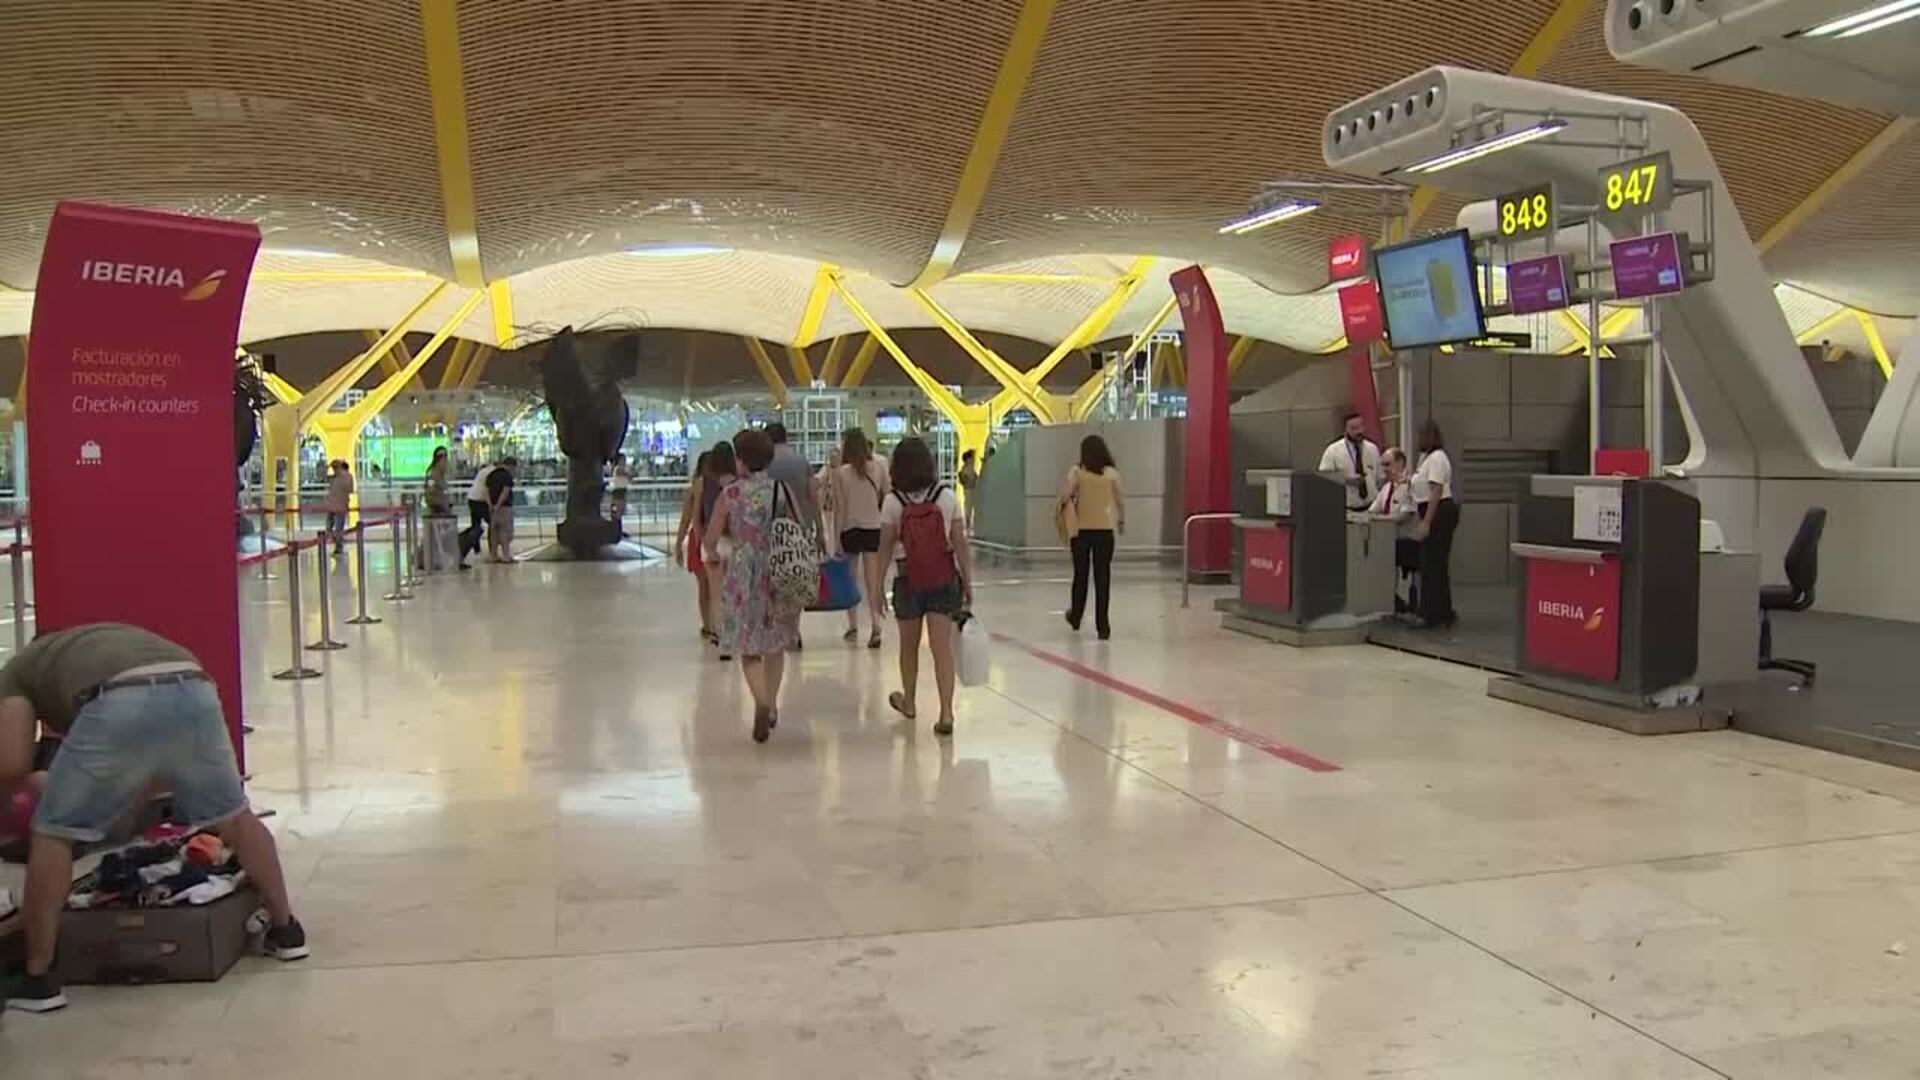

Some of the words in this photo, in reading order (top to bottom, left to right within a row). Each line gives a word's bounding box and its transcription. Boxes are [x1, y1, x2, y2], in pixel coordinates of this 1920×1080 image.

[1606, 164, 1657, 211] 847
[1502, 194, 1548, 235] 848
[81, 260, 185, 288] IBERIA
[72, 347, 160, 367] Facturación
[162, 354, 181, 367] en
[72, 371, 167, 388] mostradores
[72, 395, 136, 412] Check-in
[138, 398, 199, 414] counters
[1538, 599, 1585, 620] IBERIA
